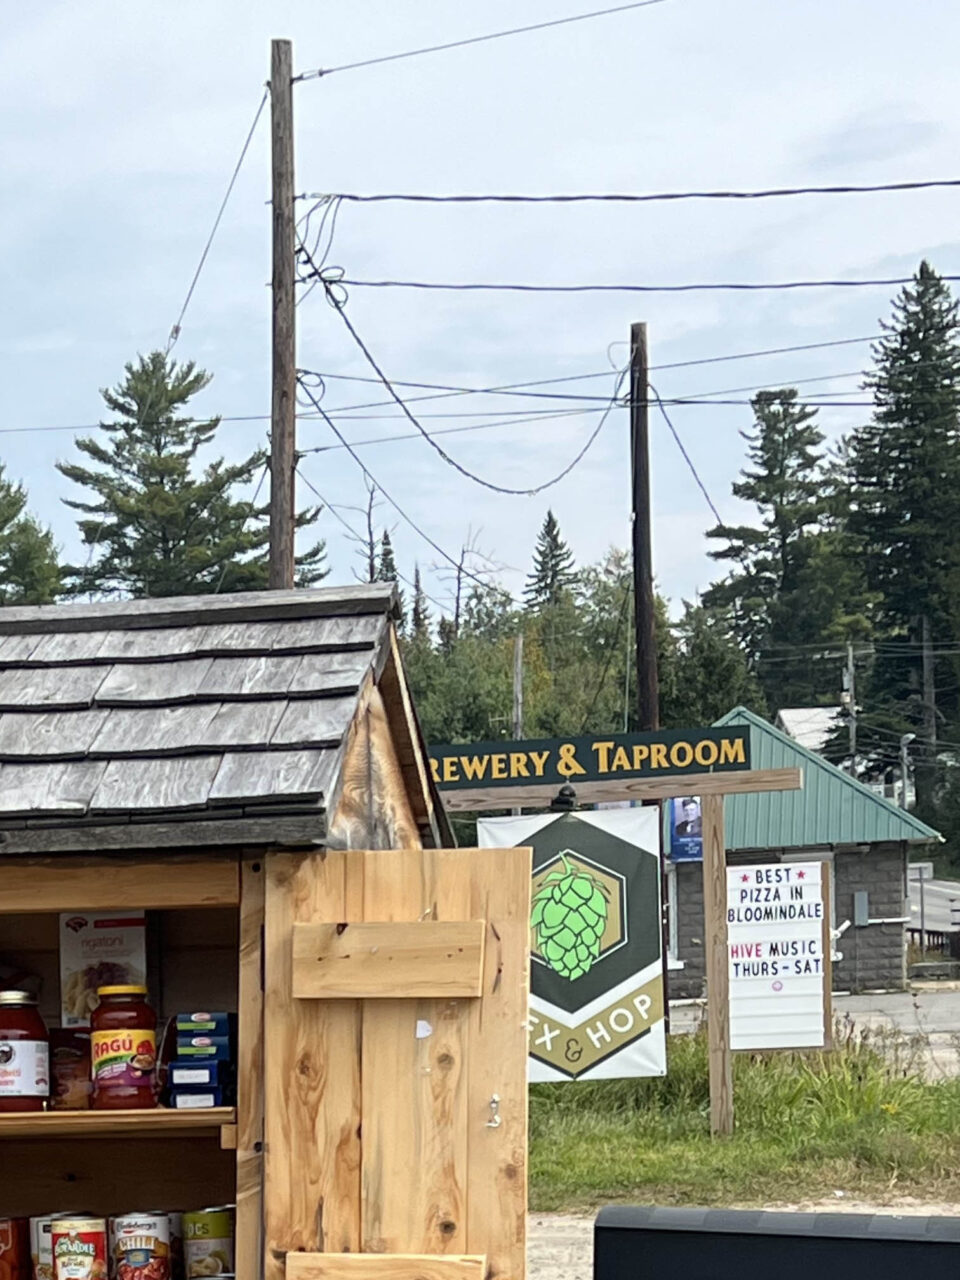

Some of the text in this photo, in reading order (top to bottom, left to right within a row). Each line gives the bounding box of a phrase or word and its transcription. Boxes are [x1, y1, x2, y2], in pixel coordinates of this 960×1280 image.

[557, 743, 587, 777] &
[592, 738, 746, 773] TAPROOM
[756, 868, 791, 884] BEST
[740, 886, 803, 903] PIZZA IN
[728, 903, 821, 922] BLOOMINDALE
[731, 940, 817, 958] HIVE MUSIC
[564, 1038, 583, 1063] &
[586, 994, 652, 1048] HOP
